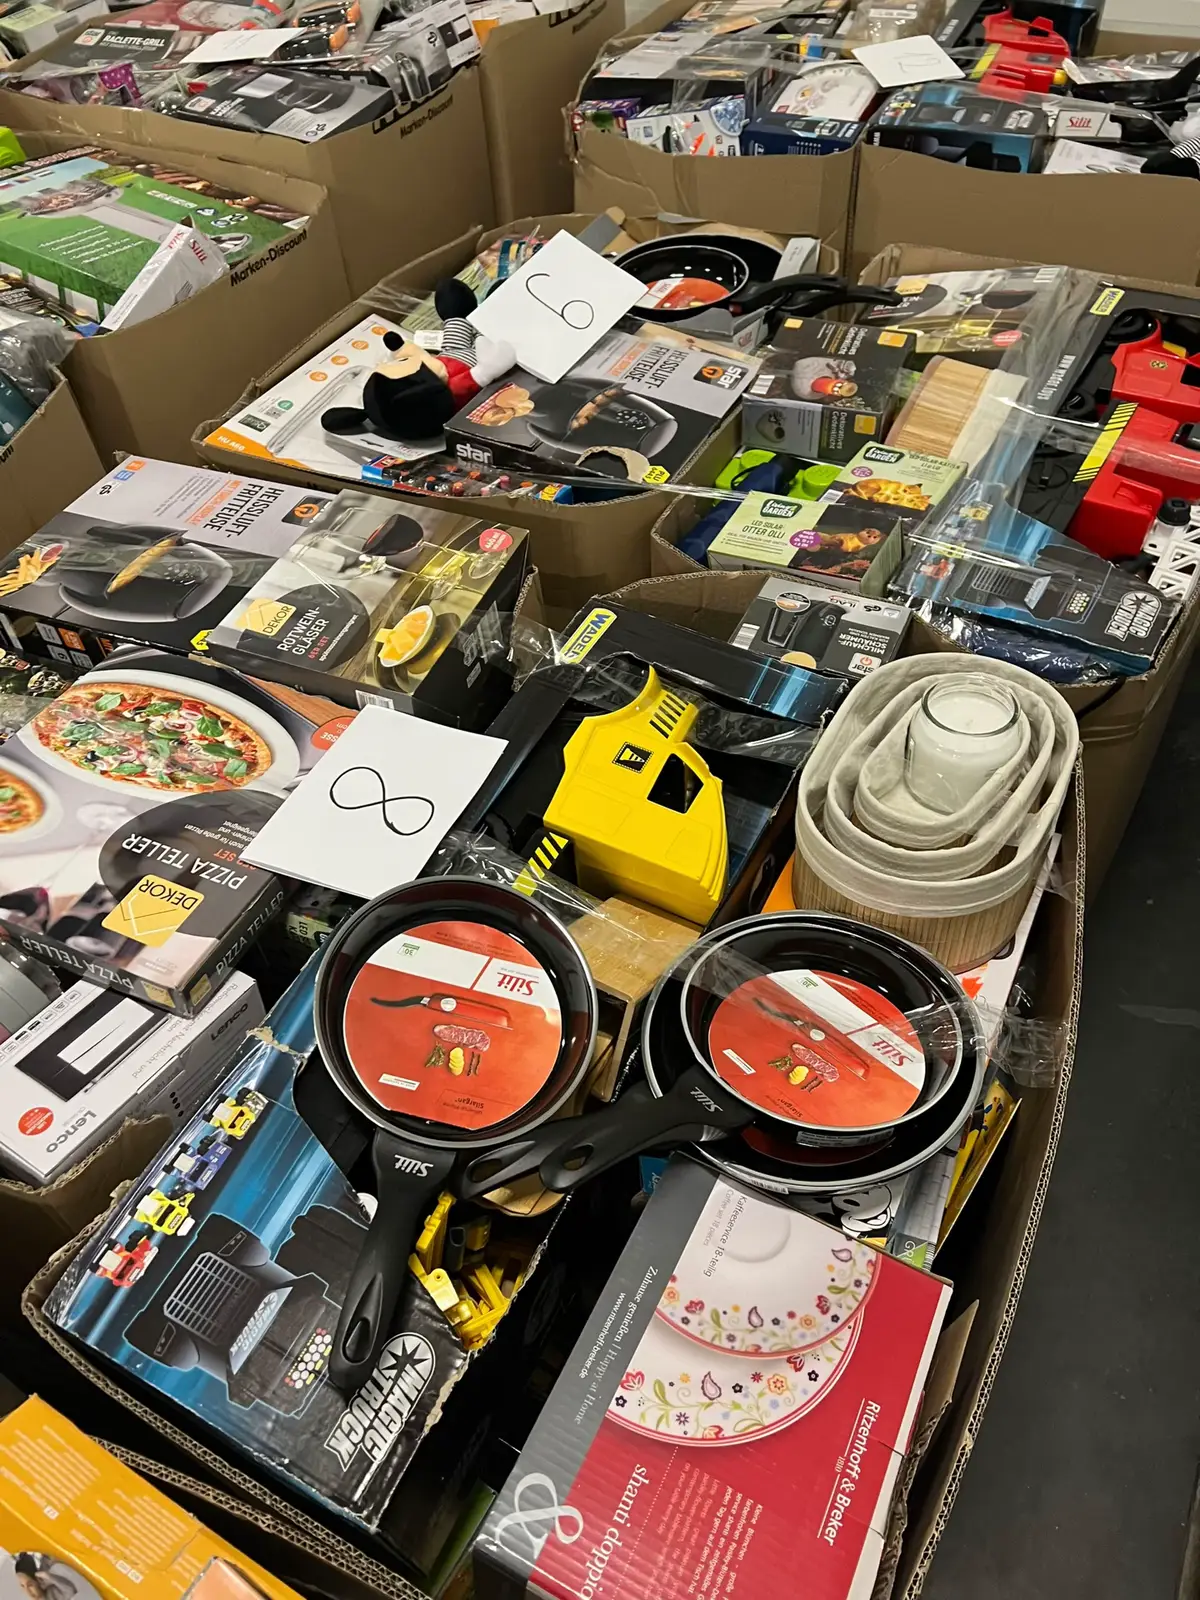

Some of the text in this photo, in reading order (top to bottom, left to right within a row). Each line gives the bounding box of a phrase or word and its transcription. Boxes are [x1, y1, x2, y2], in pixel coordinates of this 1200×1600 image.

[103, 34, 165, 47] RACLETTE-GRILL
[1066, 116, 1093, 129] Silit
[190, 239, 208, 265] Silit
[230, 229, 309, 287] Marken-Discount
[525, 273, 595, 330] 6
[624, 345, 669, 384] FRITTEUSE
[647, 349, 690, 390] HEISSLUFT-
[723, 365, 743, 389] star
[828, 410, 838, 449] Gedenklicht
[837, 410, 847, 449] Dekoratives
[456, 443, 491, 464] star
[865, 452, 899, 463] GARDEN
[653, 469, 665, 483] PLU
[202, 483, 264, 531] FRITTEUSE
[225, 487, 284, 538] HEISSLUFT-
[762, 506, 794, 518] GARDEN
[742, 525, 768, 536] OTTER
[768, 529, 786, 539] OLLI
[262, 603, 293, 637] DEKOR
[863, 604, 882, 614] GS
[1107, 604, 1137, 639] TRUCK
[1130, 602, 1158, 637] MAGIC
[276, 606, 320, 652] ROTWEIN-
[292, 618, 329, 656] GLÄSER
[838, 633, 888, 649] SCHÄUMER
[837, 639, 885, 654] MILCHAUF-
[852, 663, 874, 674] star
[329, 765, 435, 837] 8
[121, 832, 248, 890] PIZZA TELLER
[214, 848, 237, 862] SET
[138, 878, 198, 911] DEKOR
[215, 890, 285, 976] PIZZA TELLER
[298, 921, 308, 936] LED
[20, 934, 133, 988] PIZZA TELLER
[496, 972, 540, 998] Silit
[211, 1003, 249, 1041] Lenco
[147, 1030, 184, 1066] Nachtlicht
[868, 1036, 914, 1068] Silit
[132, 1064, 147, 1079] und
[691, 1087, 724, 1113] Silit
[46, 1109, 97, 1153] Lenco
[394, 1154, 434, 1177] Silit
[716, 1209, 724, 1219] set
[721, 1189, 734, 1209] Coffee
[704, 1195, 746, 1278] Kaffeeservice 18-teilig
[712, 1219, 721, 1228] 18
[632, 1266, 659, 1306] Zuhause
[578, 1291, 627, 1380] www.ritzenhoff-breker.de
[613, 1302, 640, 1344] genießen
[593, 1348, 617, 1383] Happy
[328, 1367, 394, 1464] TRUCK
[362, 1363, 425, 1461] MAGIC
[573, 1393, 597, 1426] Home
[823, 1400, 881, 1547] Ritzenhoff & Breker
[834, 1455, 846, 1473] 1810
[612, 1463, 650, 1528] shanti
[716, 1505, 727, 1518] Tag
[721, 1486, 734, 1505] jeden
[730, 1492, 743, 1515] service
[710, 1517, 722, 1534] gern
[732, 1498, 753, 1540] farbenfrohen
[700, 1546, 711, 1562] dem
[724, 1504, 763, 1593] Kleine Blümchen große
[693, 1563, 704, 1581] Tisch
